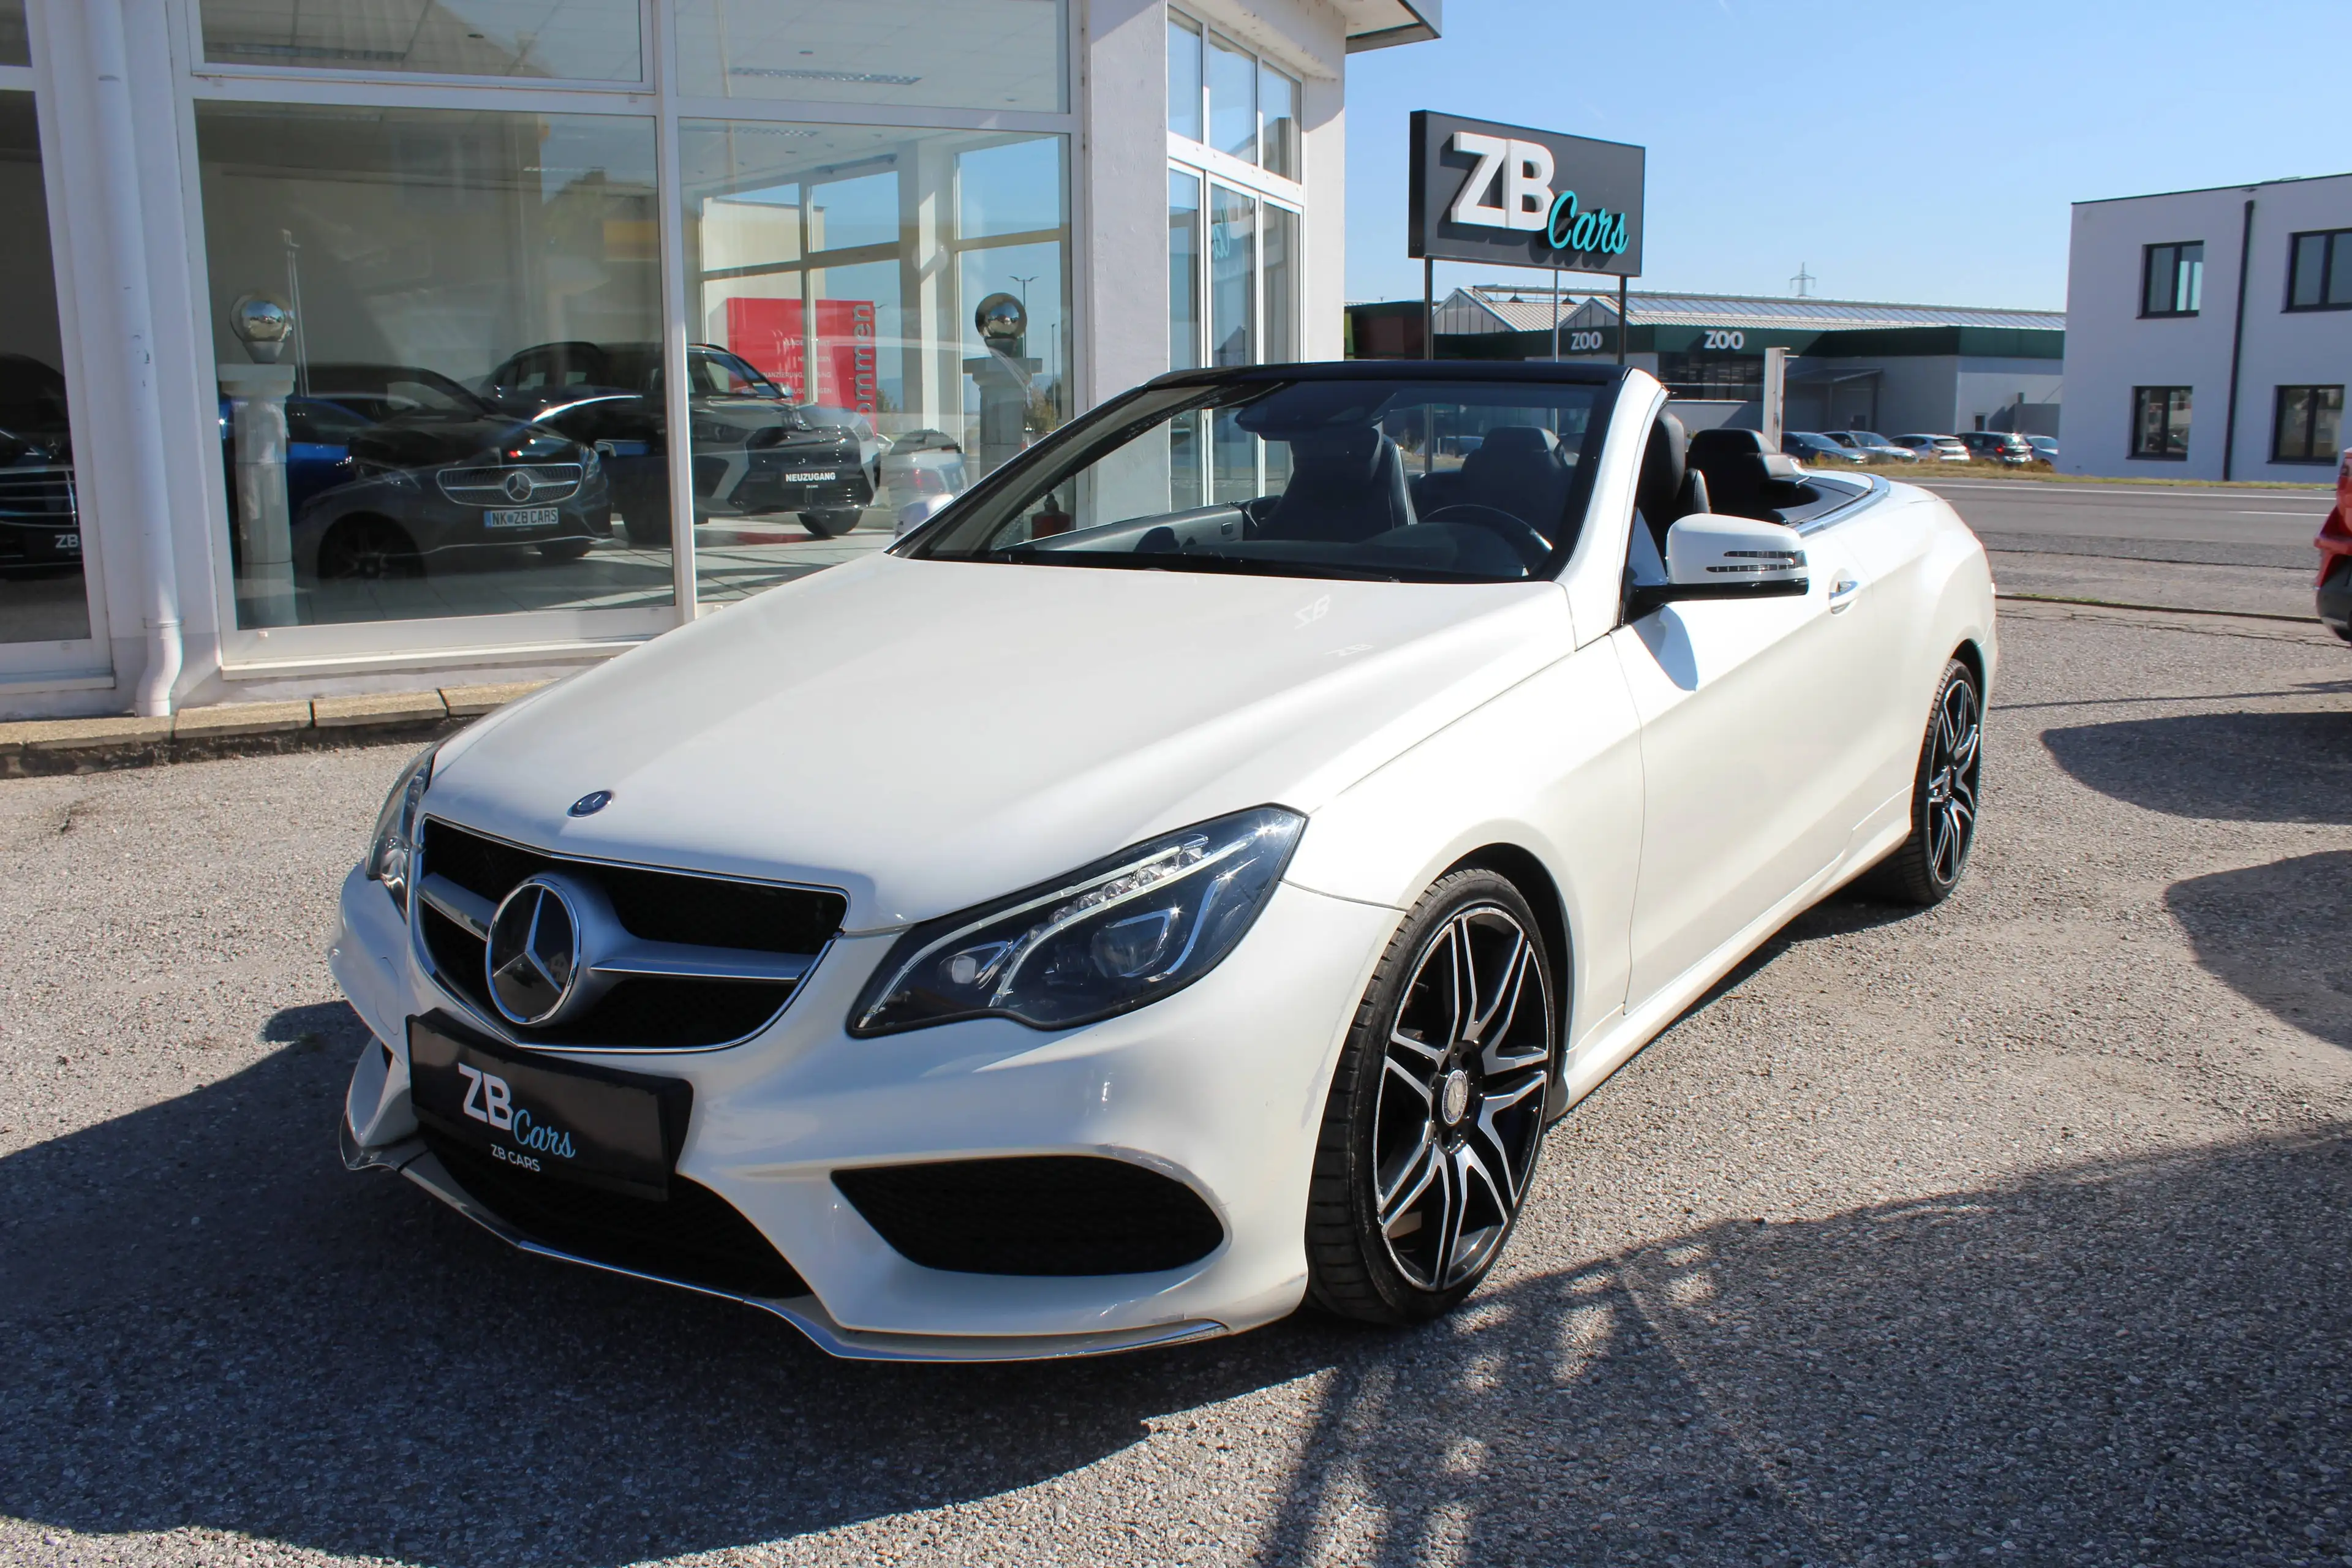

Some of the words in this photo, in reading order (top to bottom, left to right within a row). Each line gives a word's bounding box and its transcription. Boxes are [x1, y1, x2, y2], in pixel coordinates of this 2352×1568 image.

[1450, 131, 1555, 232] ZB
[1548, 190, 1629, 255] Cars
[1570, 331, 1603, 350] ZOO
[1703, 330, 1744, 349] ZOO
[785, 472, 836, 482] NEUZUGANG
[492, 511, 507, 525] NK
[514, 511, 528, 524] ZB
[530, 510, 558, 523] CARS
[55, 534, 78, 548] ZB
[458, 1062, 514, 1131] ZB
[513, 1109, 576, 1158] Cars
[491, 1144, 506, 1161] ZB
[508, 1151, 540, 1172] CARS
